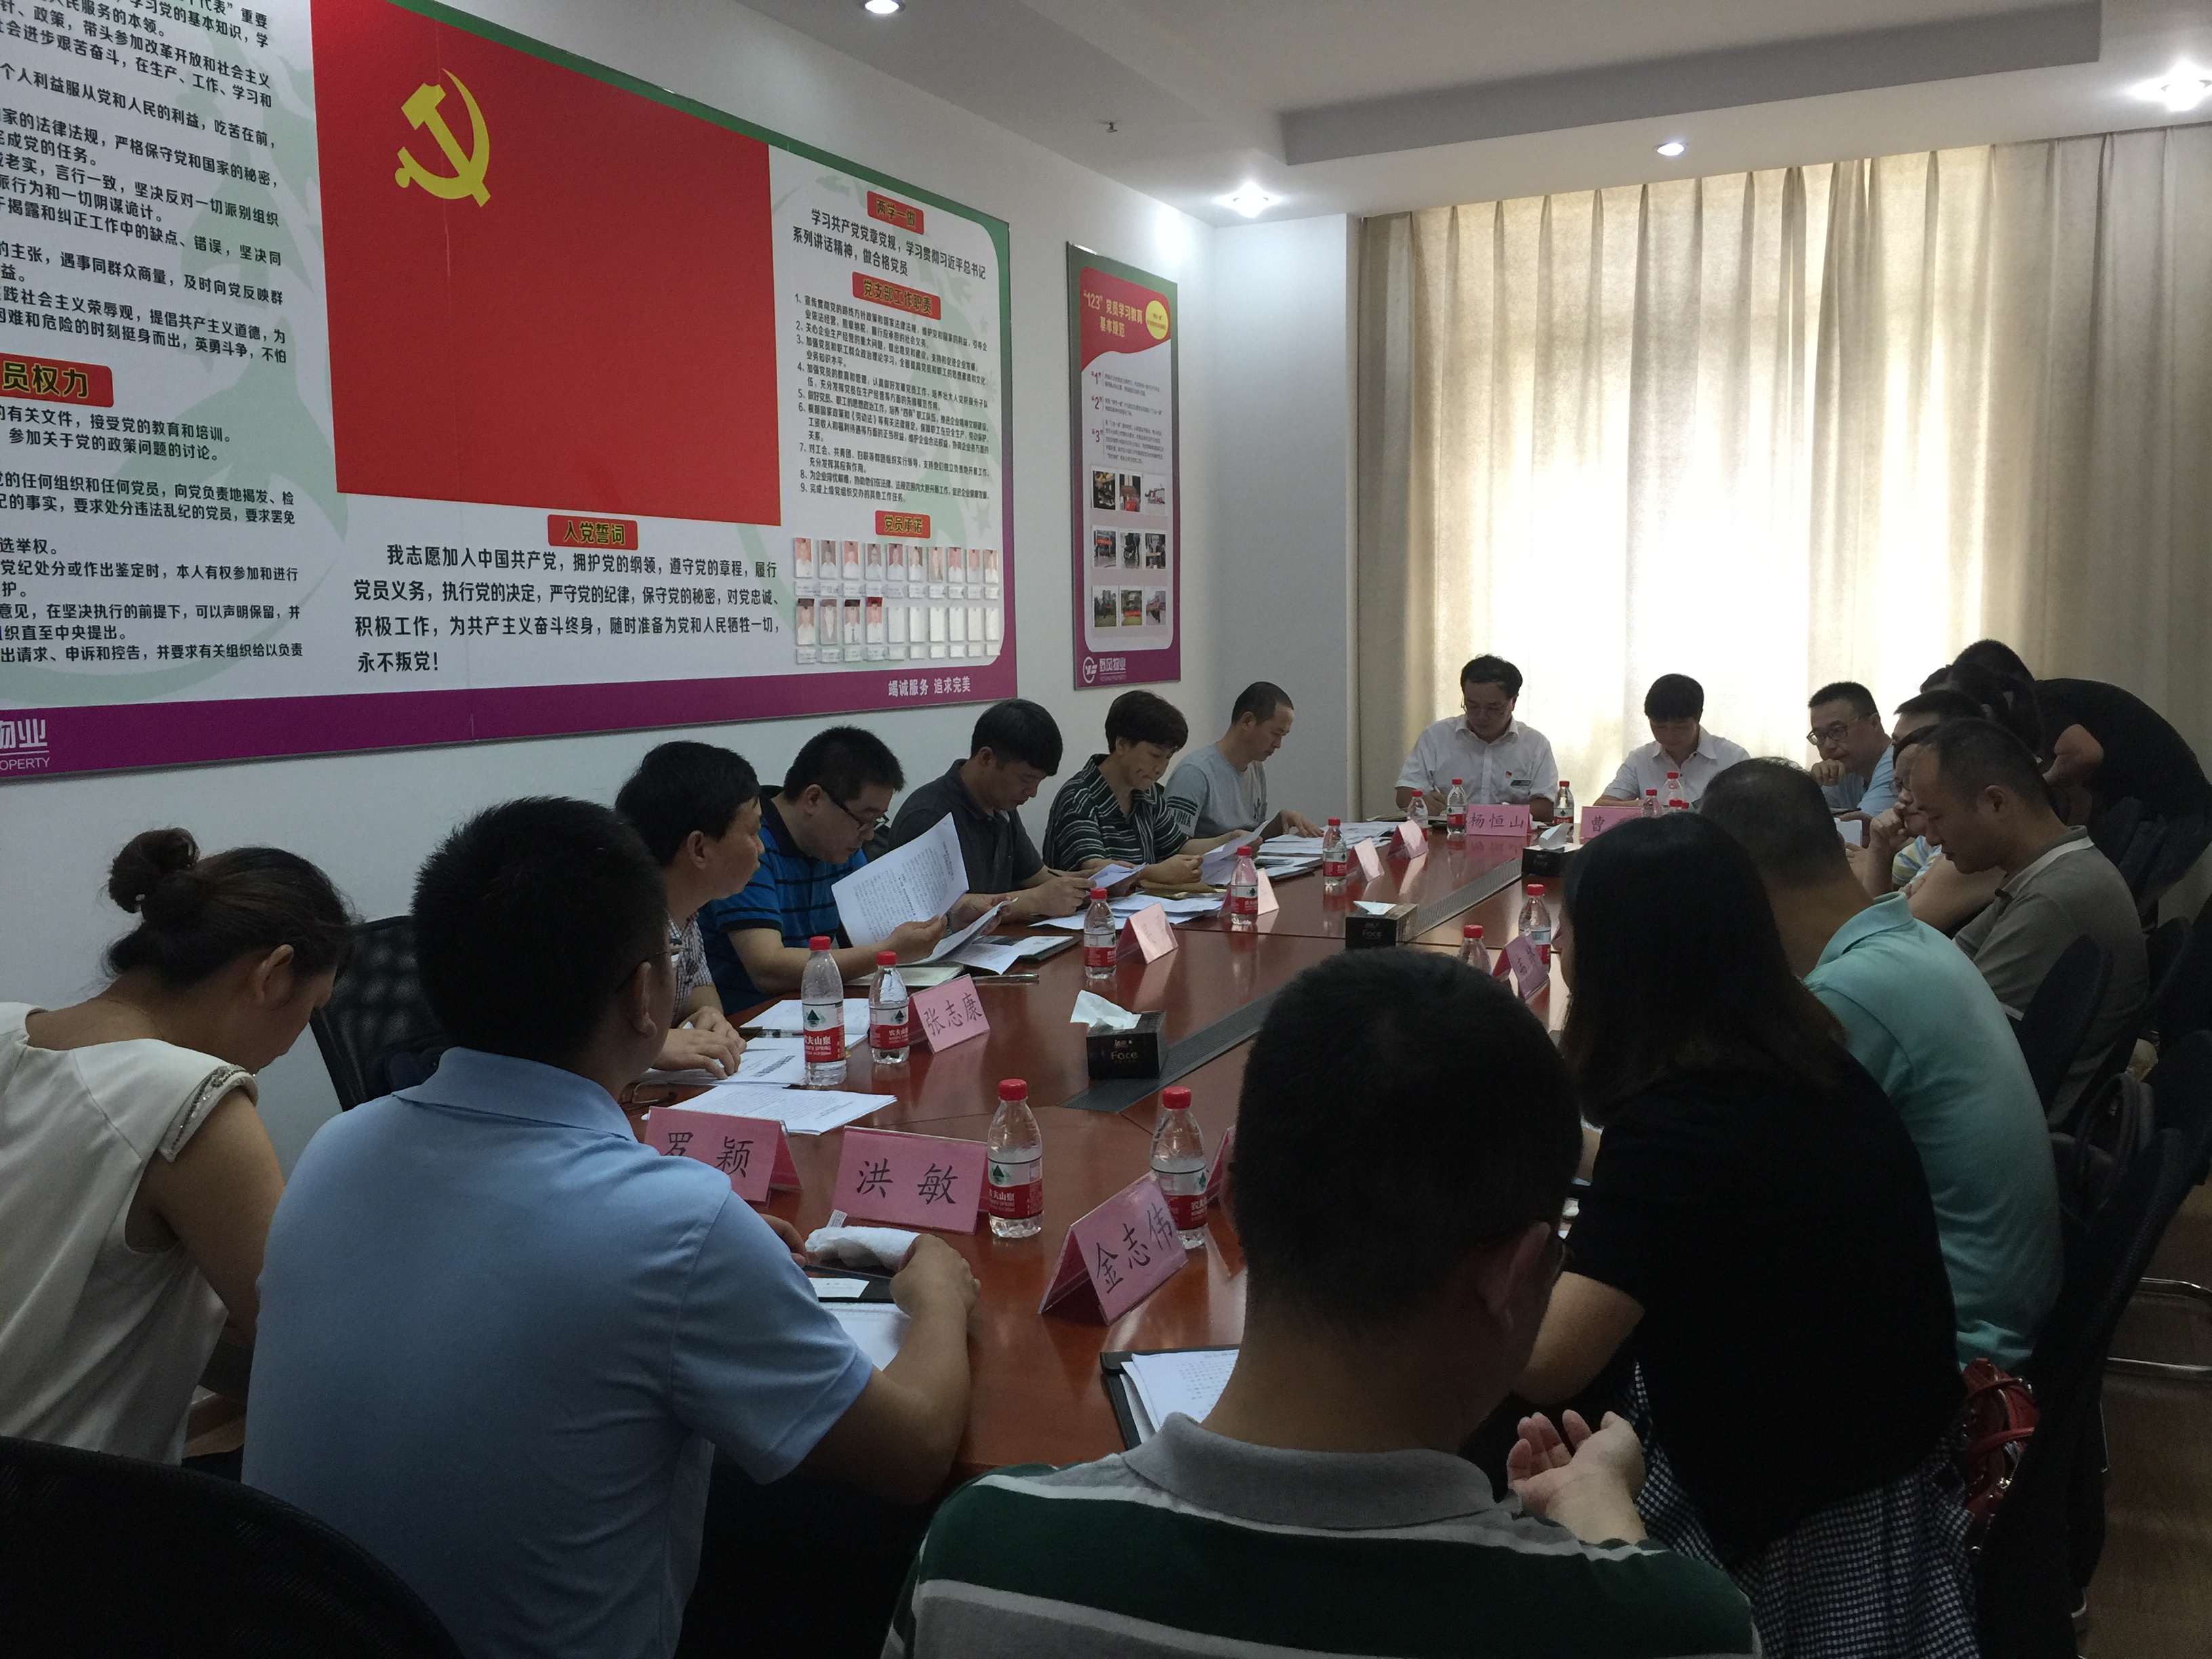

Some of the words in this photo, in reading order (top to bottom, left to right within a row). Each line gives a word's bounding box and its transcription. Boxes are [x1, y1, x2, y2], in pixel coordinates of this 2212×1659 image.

[0, 19, 272, 108] 会进步艰苦奋斗，在生产、工作、学习和
[0, 107, 277, 188] 家的法律法规，严格保守党和国家的秘密，
[876, 199, 916, 227] 两学一做
[863, 279, 933, 314] 党支部工作职责
[0, 285, 286, 345] 践社会主义荣辱观，提倡共产主义道德，为
[1, 361, 89, 398] 员权力
[9, 428, 218, 461] 参加关于党的政策问题的讨论。
[0, 471, 294, 506] 的任何组织和任何党员，向党负责地揭发、检
[562, 520, 626, 545] 入党誓词
[884, 514, 923, 534] 党员承诺
[387, 544, 778, 579] 我志愿加入中国共产党，拥护党的纲领，遵守党的章程，履行
[354, 579, 779, 607] 党员义务，执行党的决定，严守党的纪律，保守党的秘密，对党忠诚、
[0, 625, 126, 642] 织直至中央提出。
[354, 614, 780, 638] 积极工作，为共产主义奋斗终身，随时准备为党和人民牺牲一切，
[888, 679, 929, 697] 竭诚服务
[933, 676, 971, 693] 追求完美
[1468, 813, 1523, 829] 杨恒山
[1111, 1051, 1139, 1060] Face
[857, 1159, 960, 1206] 洪敏
